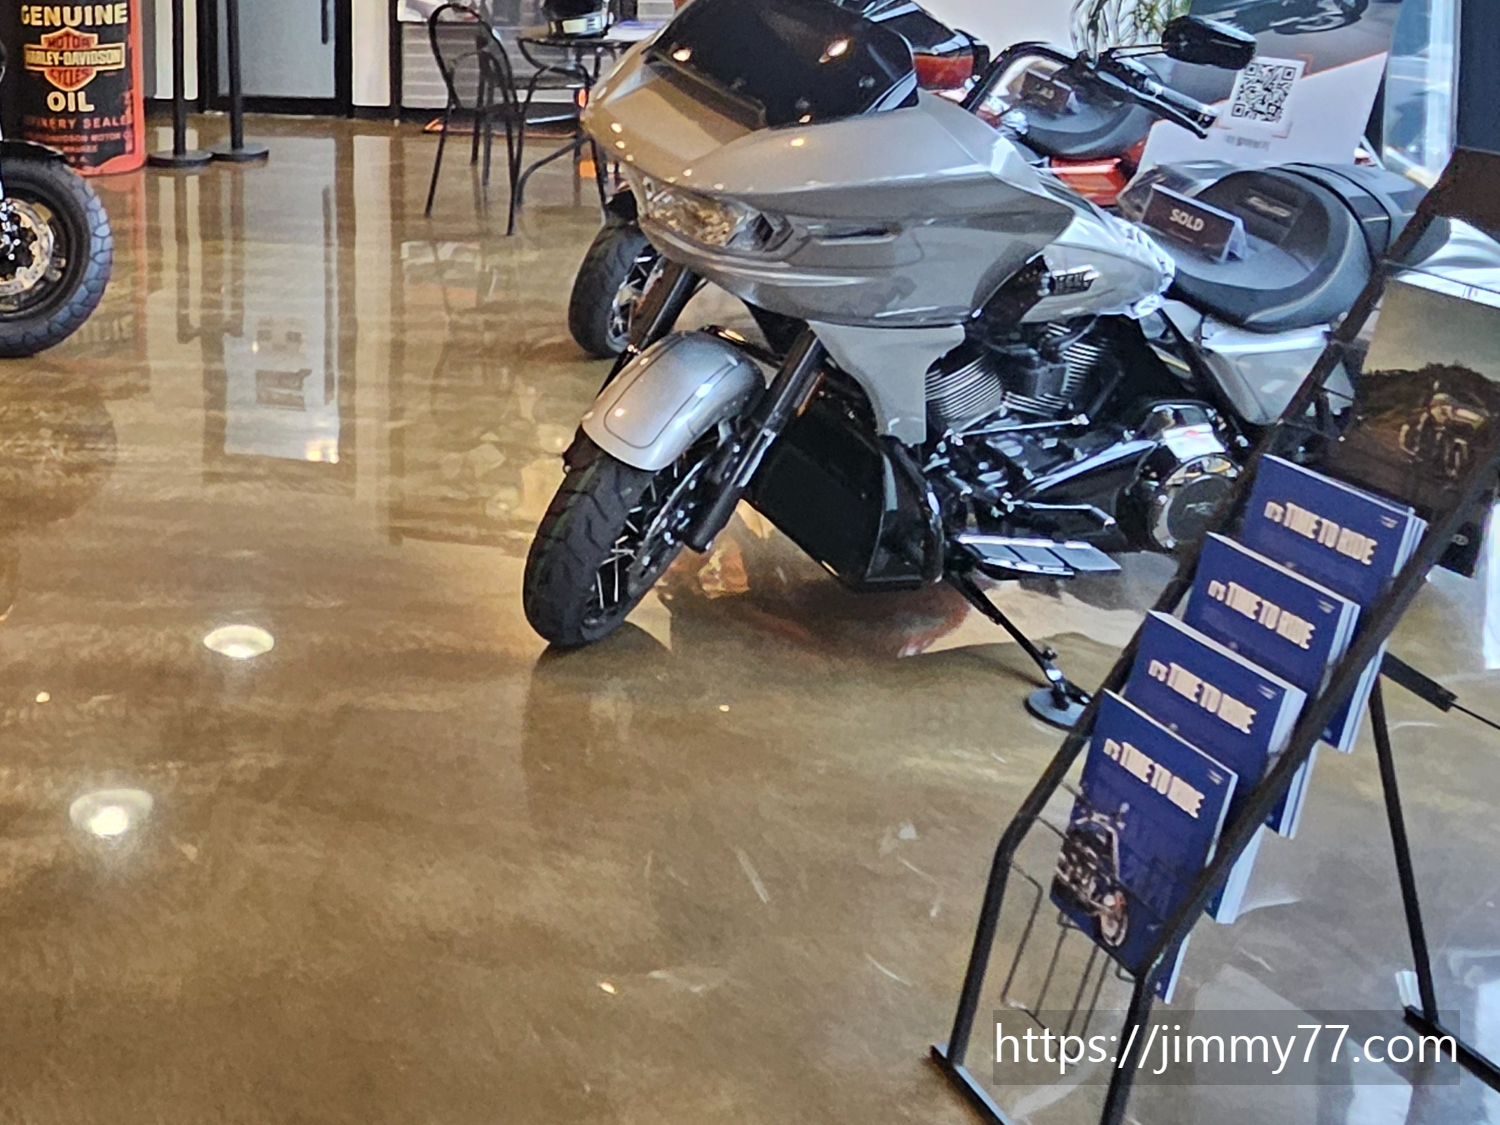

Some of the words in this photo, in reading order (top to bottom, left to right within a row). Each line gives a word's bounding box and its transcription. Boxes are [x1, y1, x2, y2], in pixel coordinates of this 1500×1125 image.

[21, 3, 127, 26] GENUINE
[46, 91, 95, 112] OIL
[1169, 208, 1205, 231] SOLD
